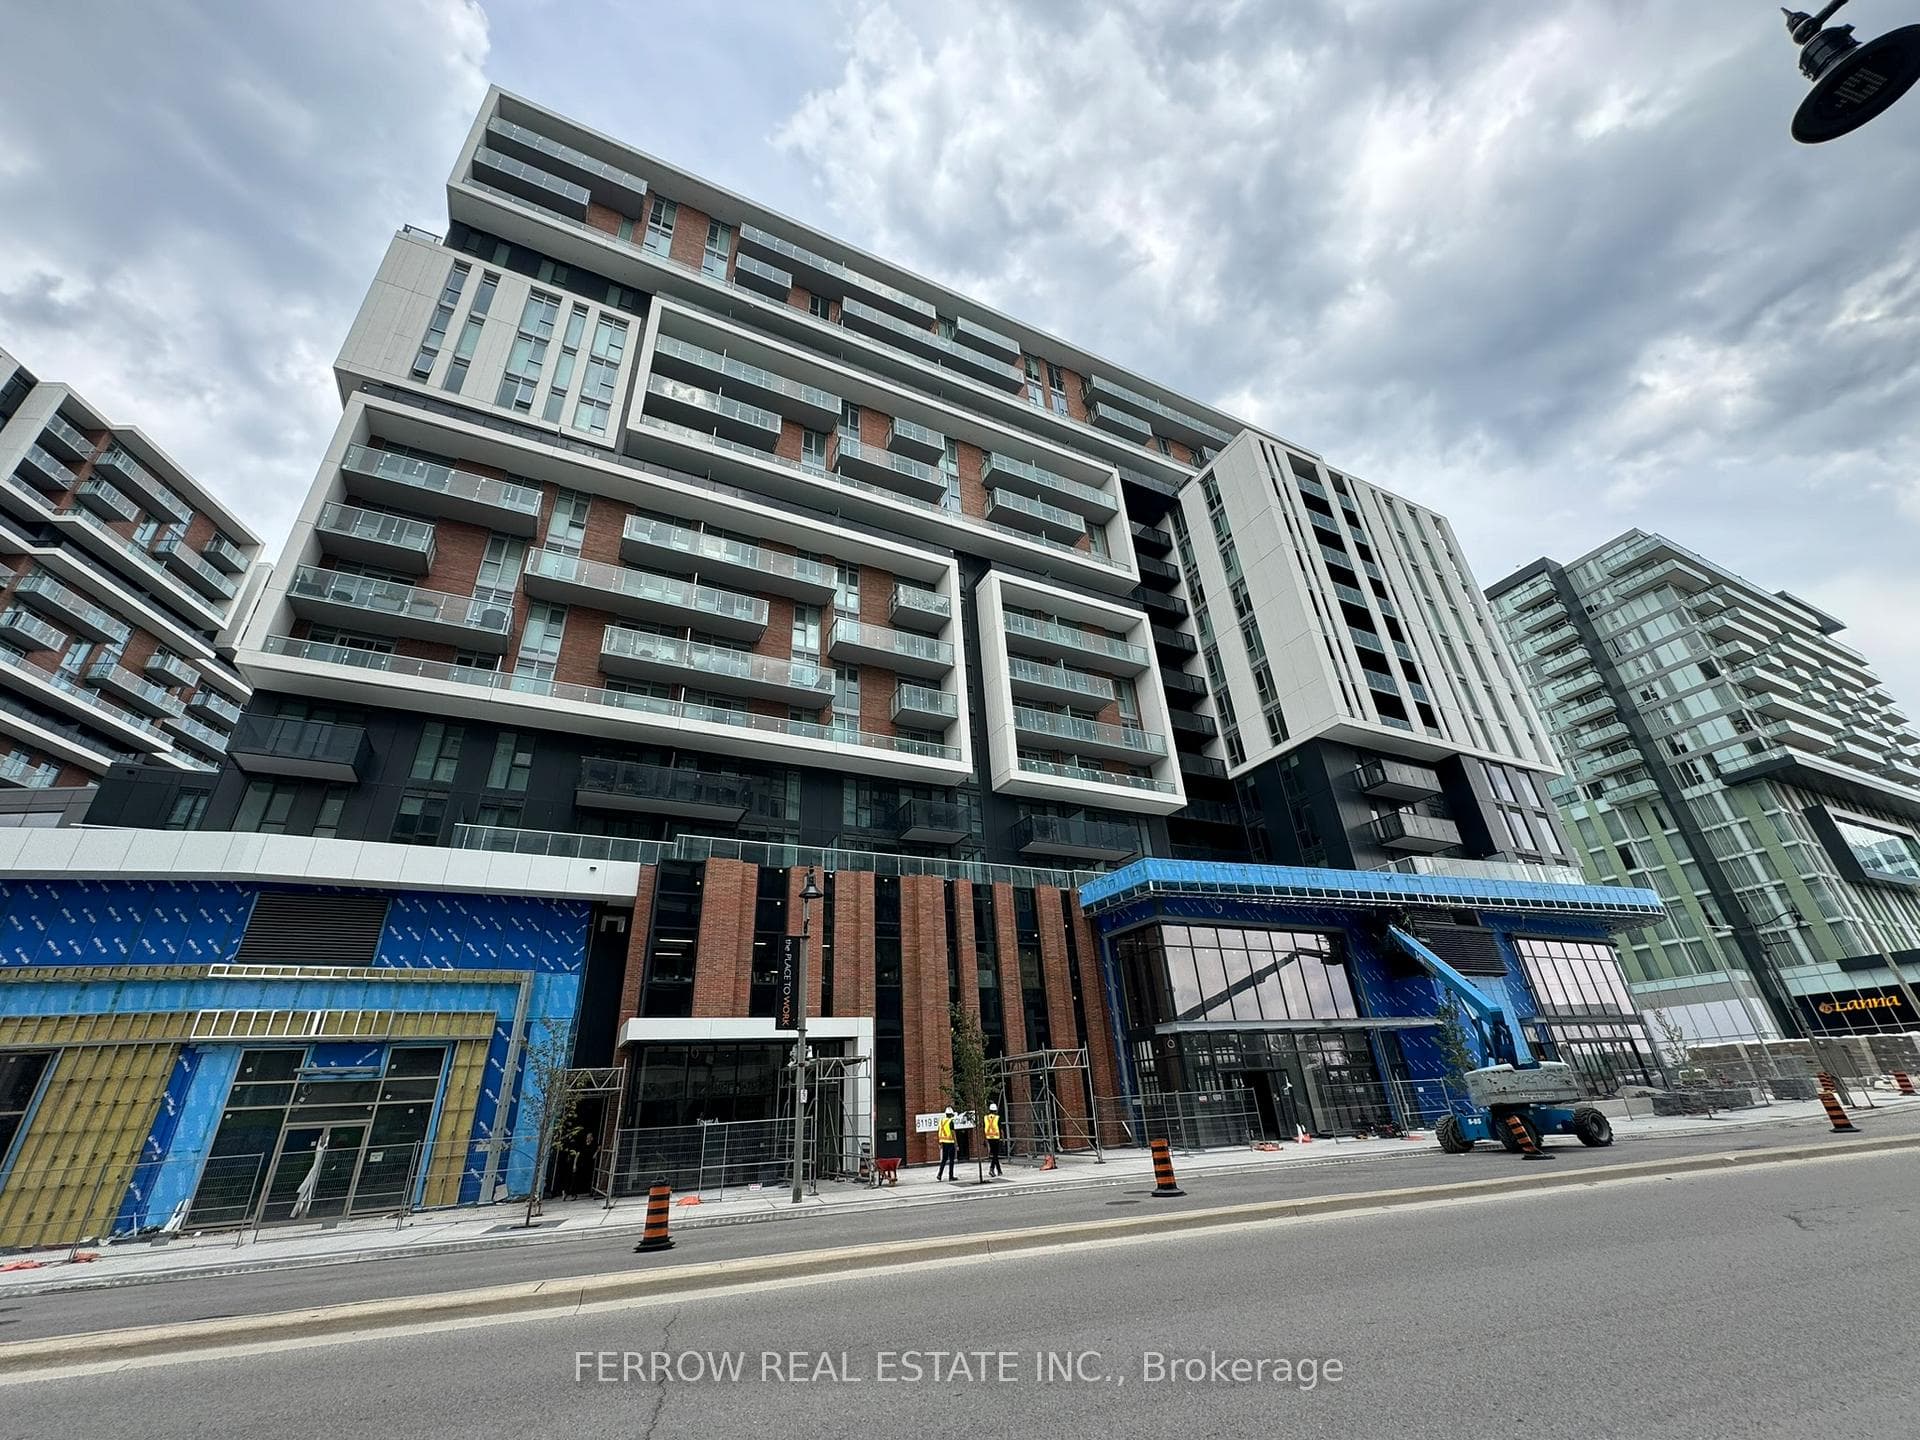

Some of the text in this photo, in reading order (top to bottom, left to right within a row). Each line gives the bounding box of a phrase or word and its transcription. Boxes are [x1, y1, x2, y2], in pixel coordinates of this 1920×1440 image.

[782, 939, 792, 1027] the PLACE TO WORK
[1834, 995, 1902, 1012] Lanna
